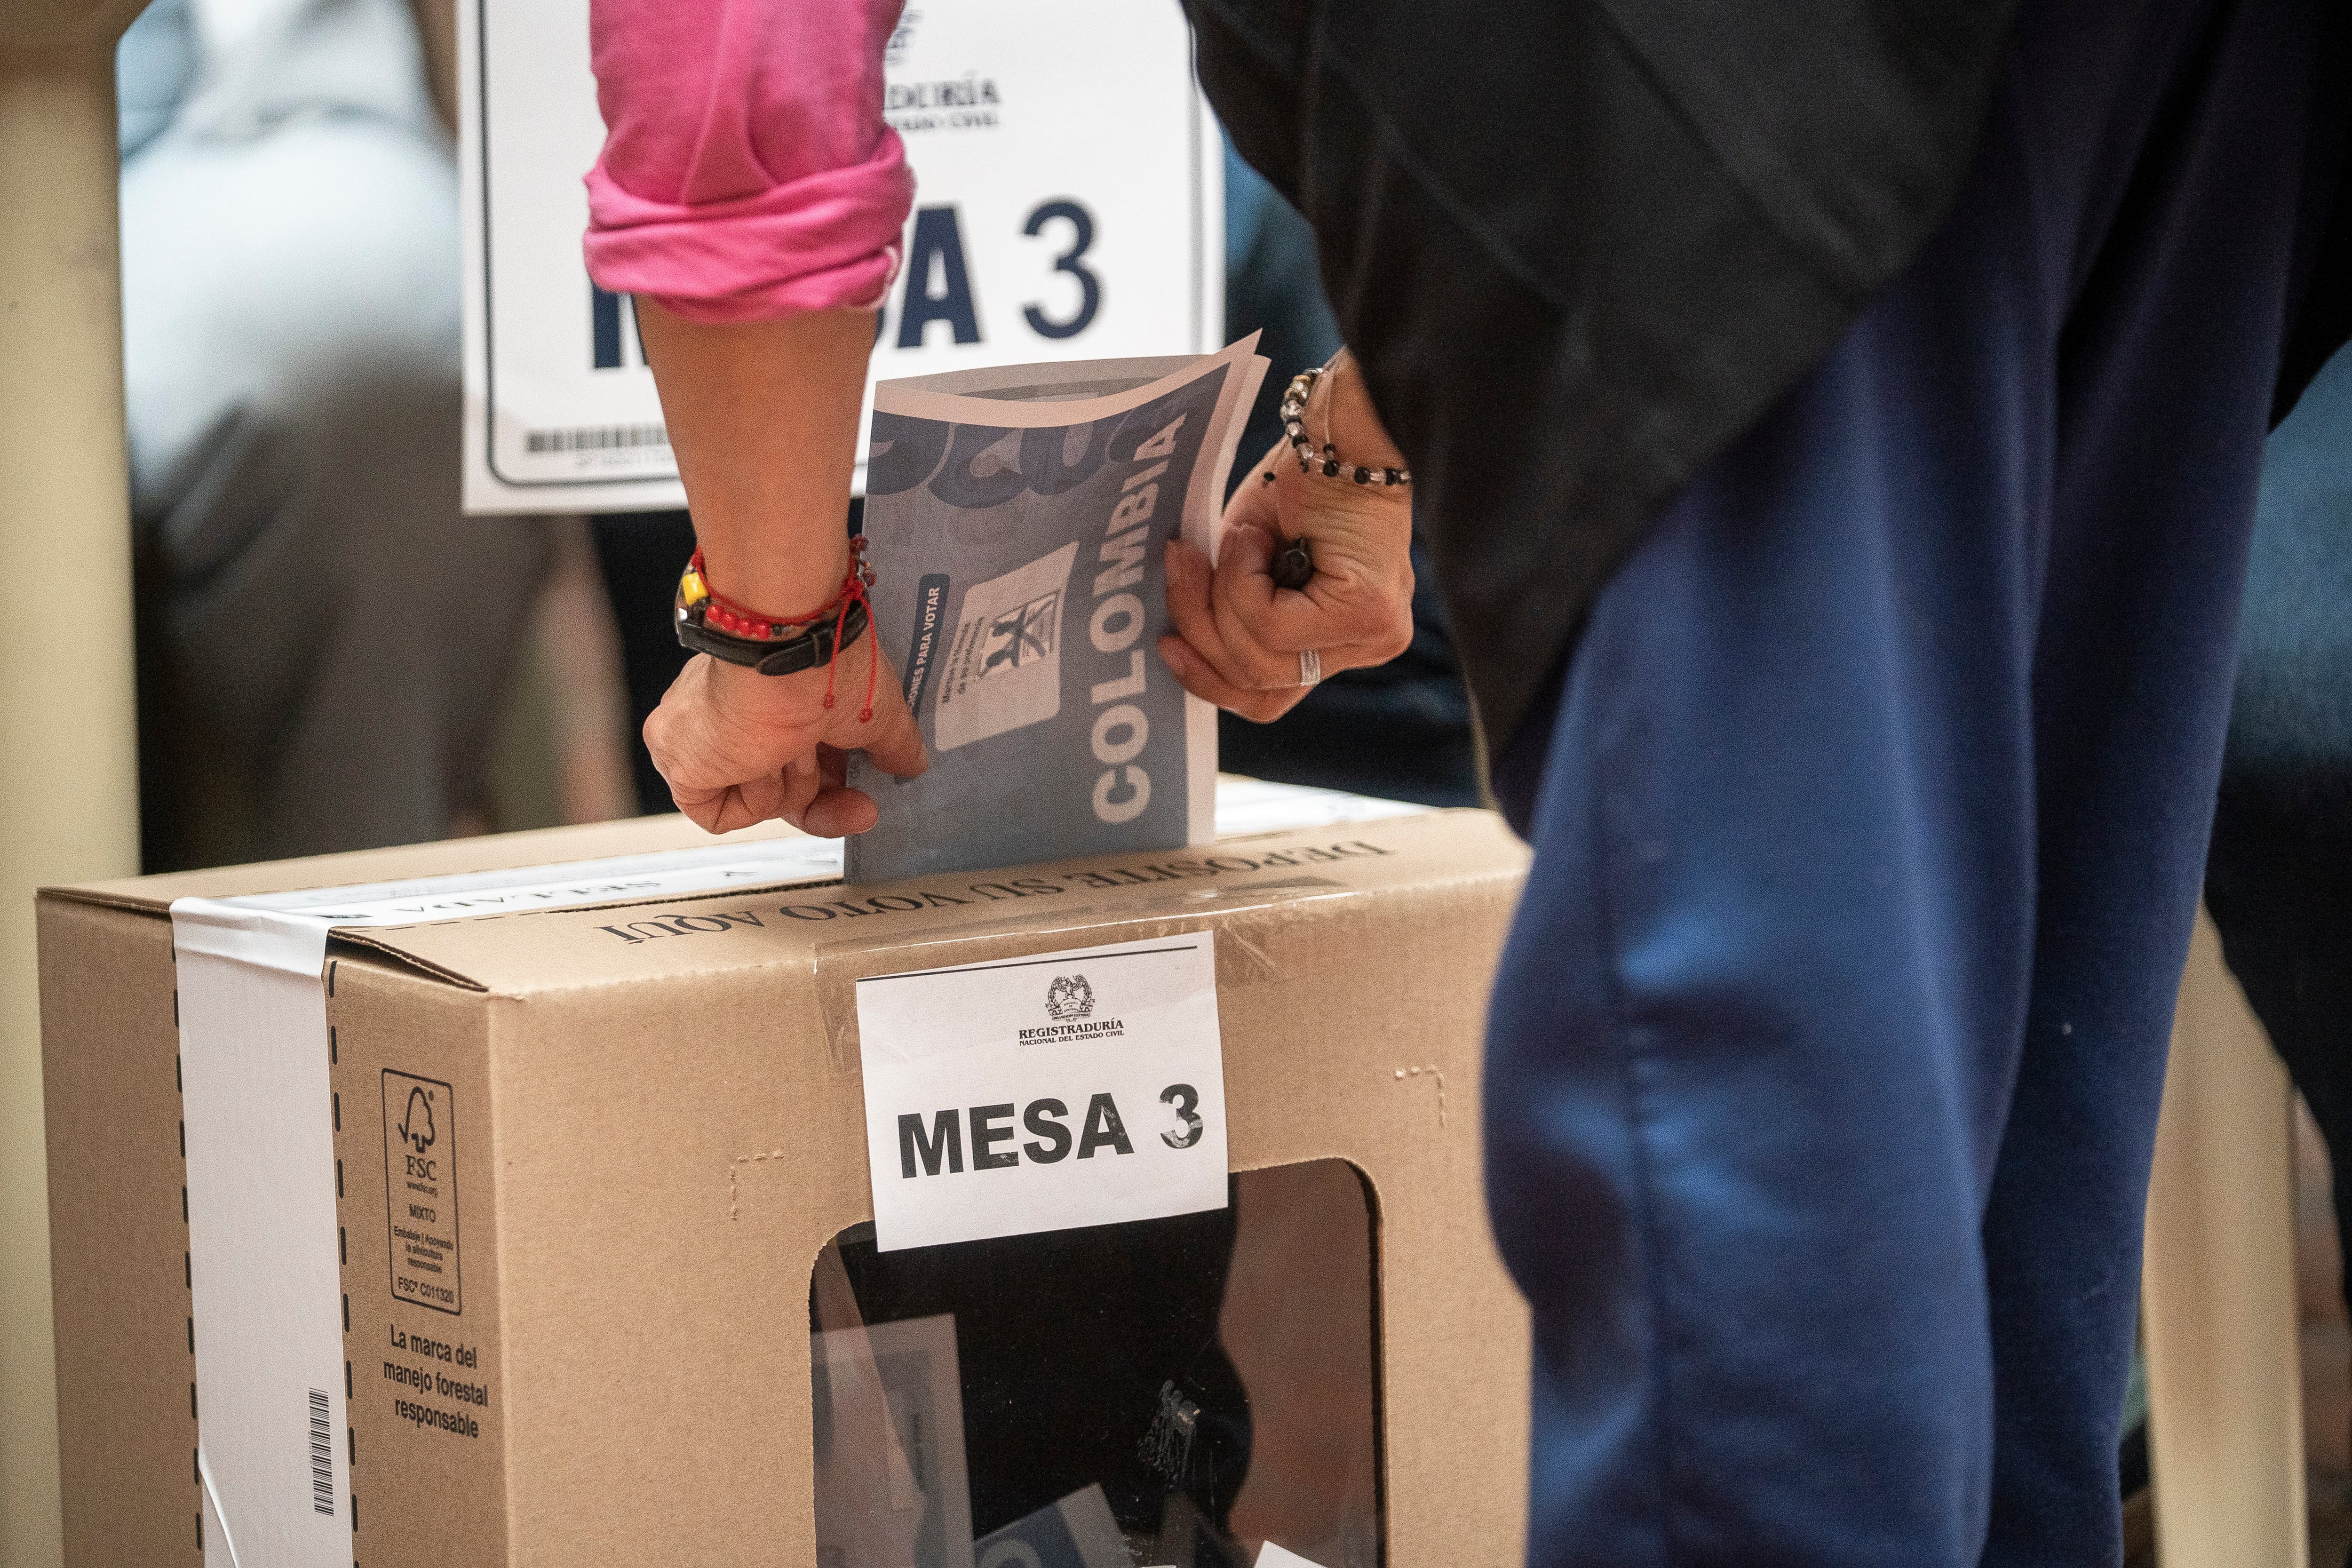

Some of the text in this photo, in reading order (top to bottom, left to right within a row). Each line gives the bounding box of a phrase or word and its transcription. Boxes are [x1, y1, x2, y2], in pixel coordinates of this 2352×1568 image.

[1022, 197, 1103, 340] 3
[923, 587, 940, 631] VOTAR
[1090, 412, 1189, 824] COLOMBIA
[916, 633, 932, 666] PARA
[594, 840, 1392, 945] DEPOSITE SU VOTO AQUÍ
[1019, 1018, 1124, 1039] REGISTRADURÍA
[1019, 1037, 1056, 1046] NACIONAL
[1076, 1032, 1104, 1041] ESTADO
[898, 1083, 1204, 1179] MESA 3
[405, 1155, 437, 1181] FSC
[409, 1204, 436, 1223] MIXTO
[391, 1324, 477, 1369] La marca del
[383, 1361, 488, 1407] manejo forestal
[395, 1399, 479, 1439] responsable
